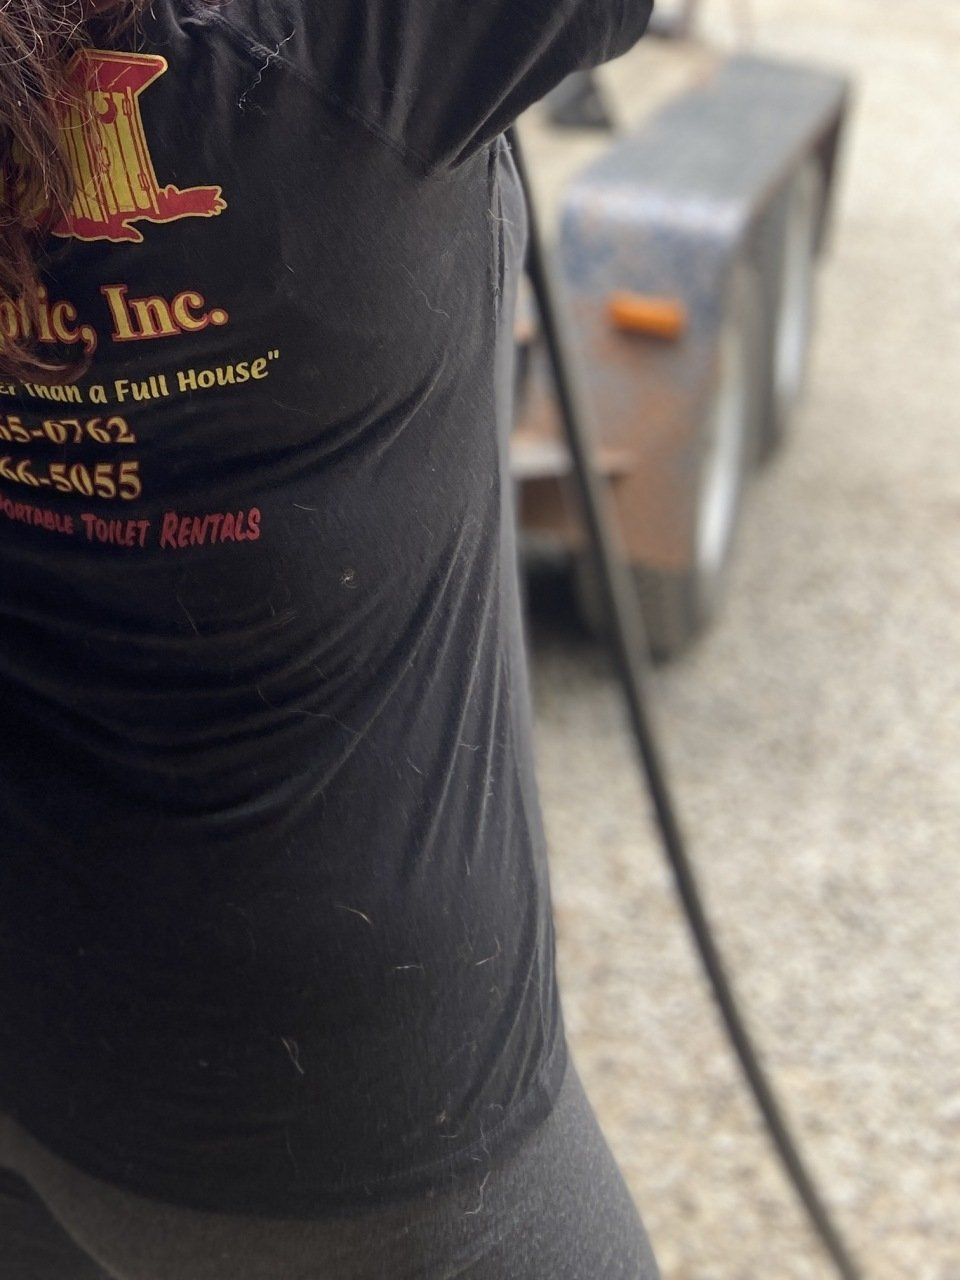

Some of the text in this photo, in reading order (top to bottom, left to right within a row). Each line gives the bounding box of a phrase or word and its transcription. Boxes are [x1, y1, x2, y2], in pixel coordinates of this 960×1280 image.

[101, 284, 229, 342] Inc.
[89, 384, 108, 405] a
[114, 374, 170, 403] Full
[176, 349, 280, 393] House"
